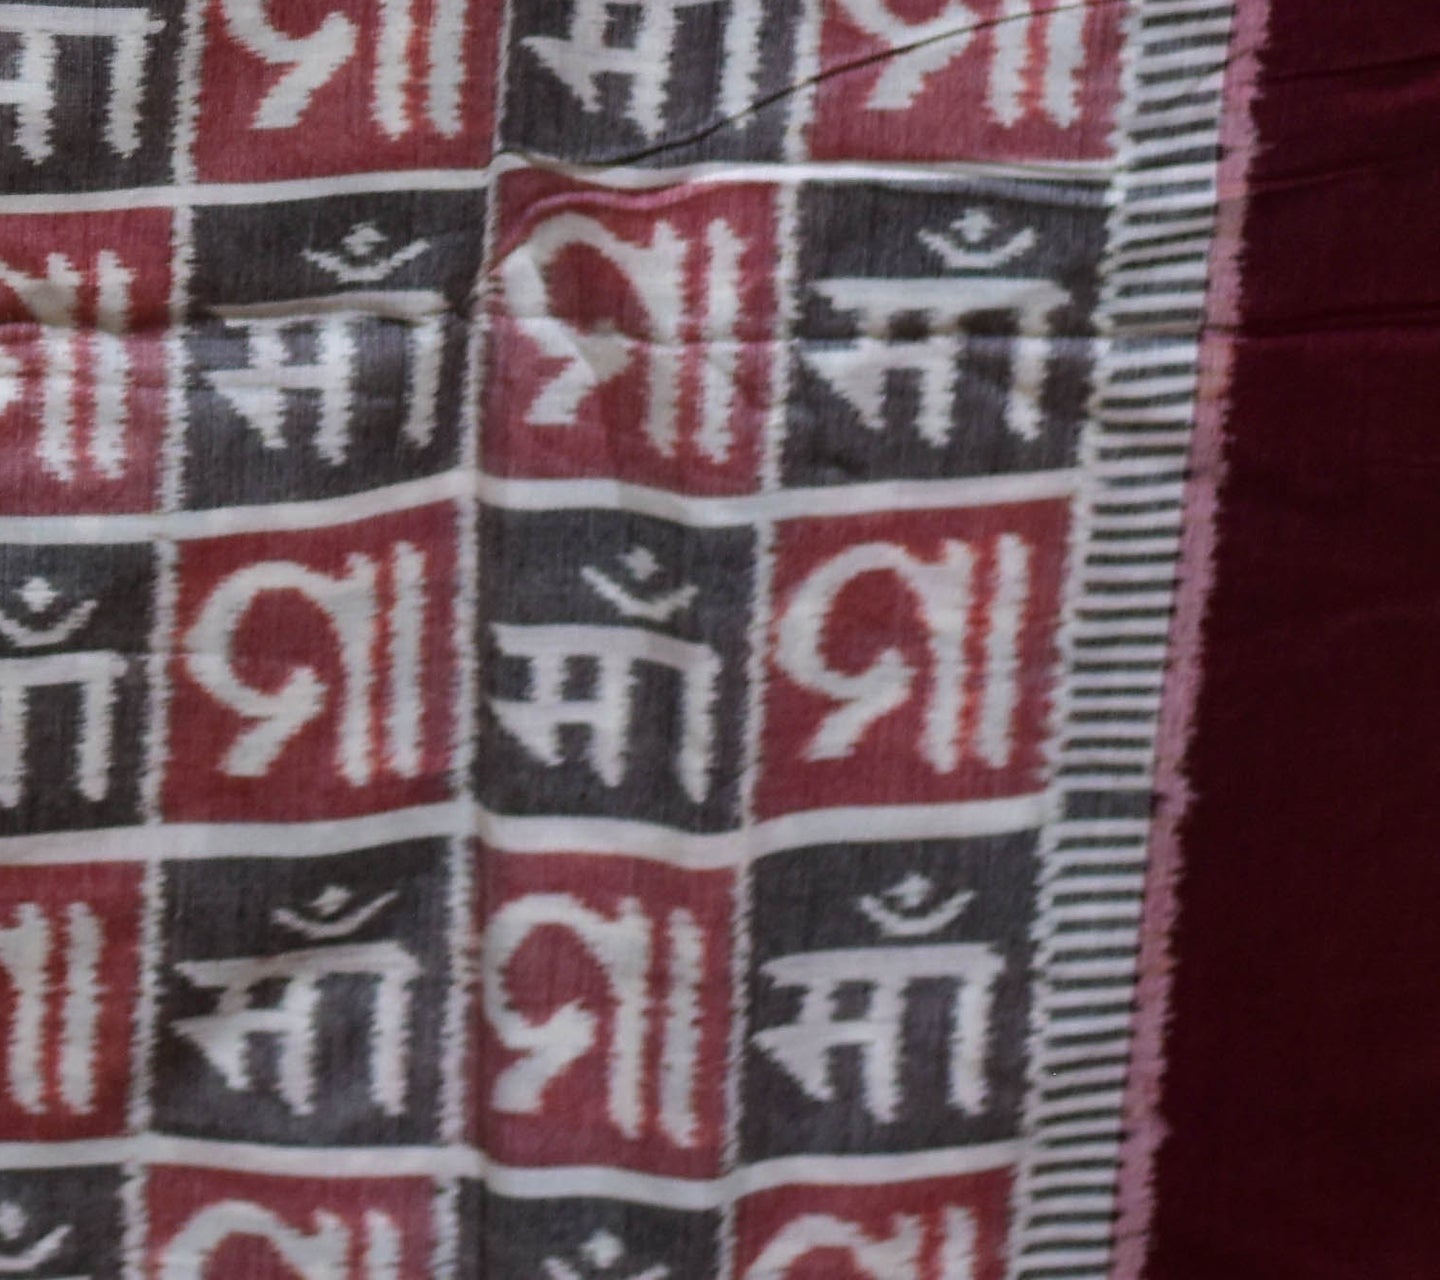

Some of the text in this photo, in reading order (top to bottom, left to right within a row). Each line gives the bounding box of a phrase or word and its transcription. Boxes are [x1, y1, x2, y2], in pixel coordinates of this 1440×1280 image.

[205, 225, 444, 463] माँ
[494, 549, 721, 802] माँ
[177, 887, 422, 1115] माँ
[760, 875, 1004, 1122] माँ
